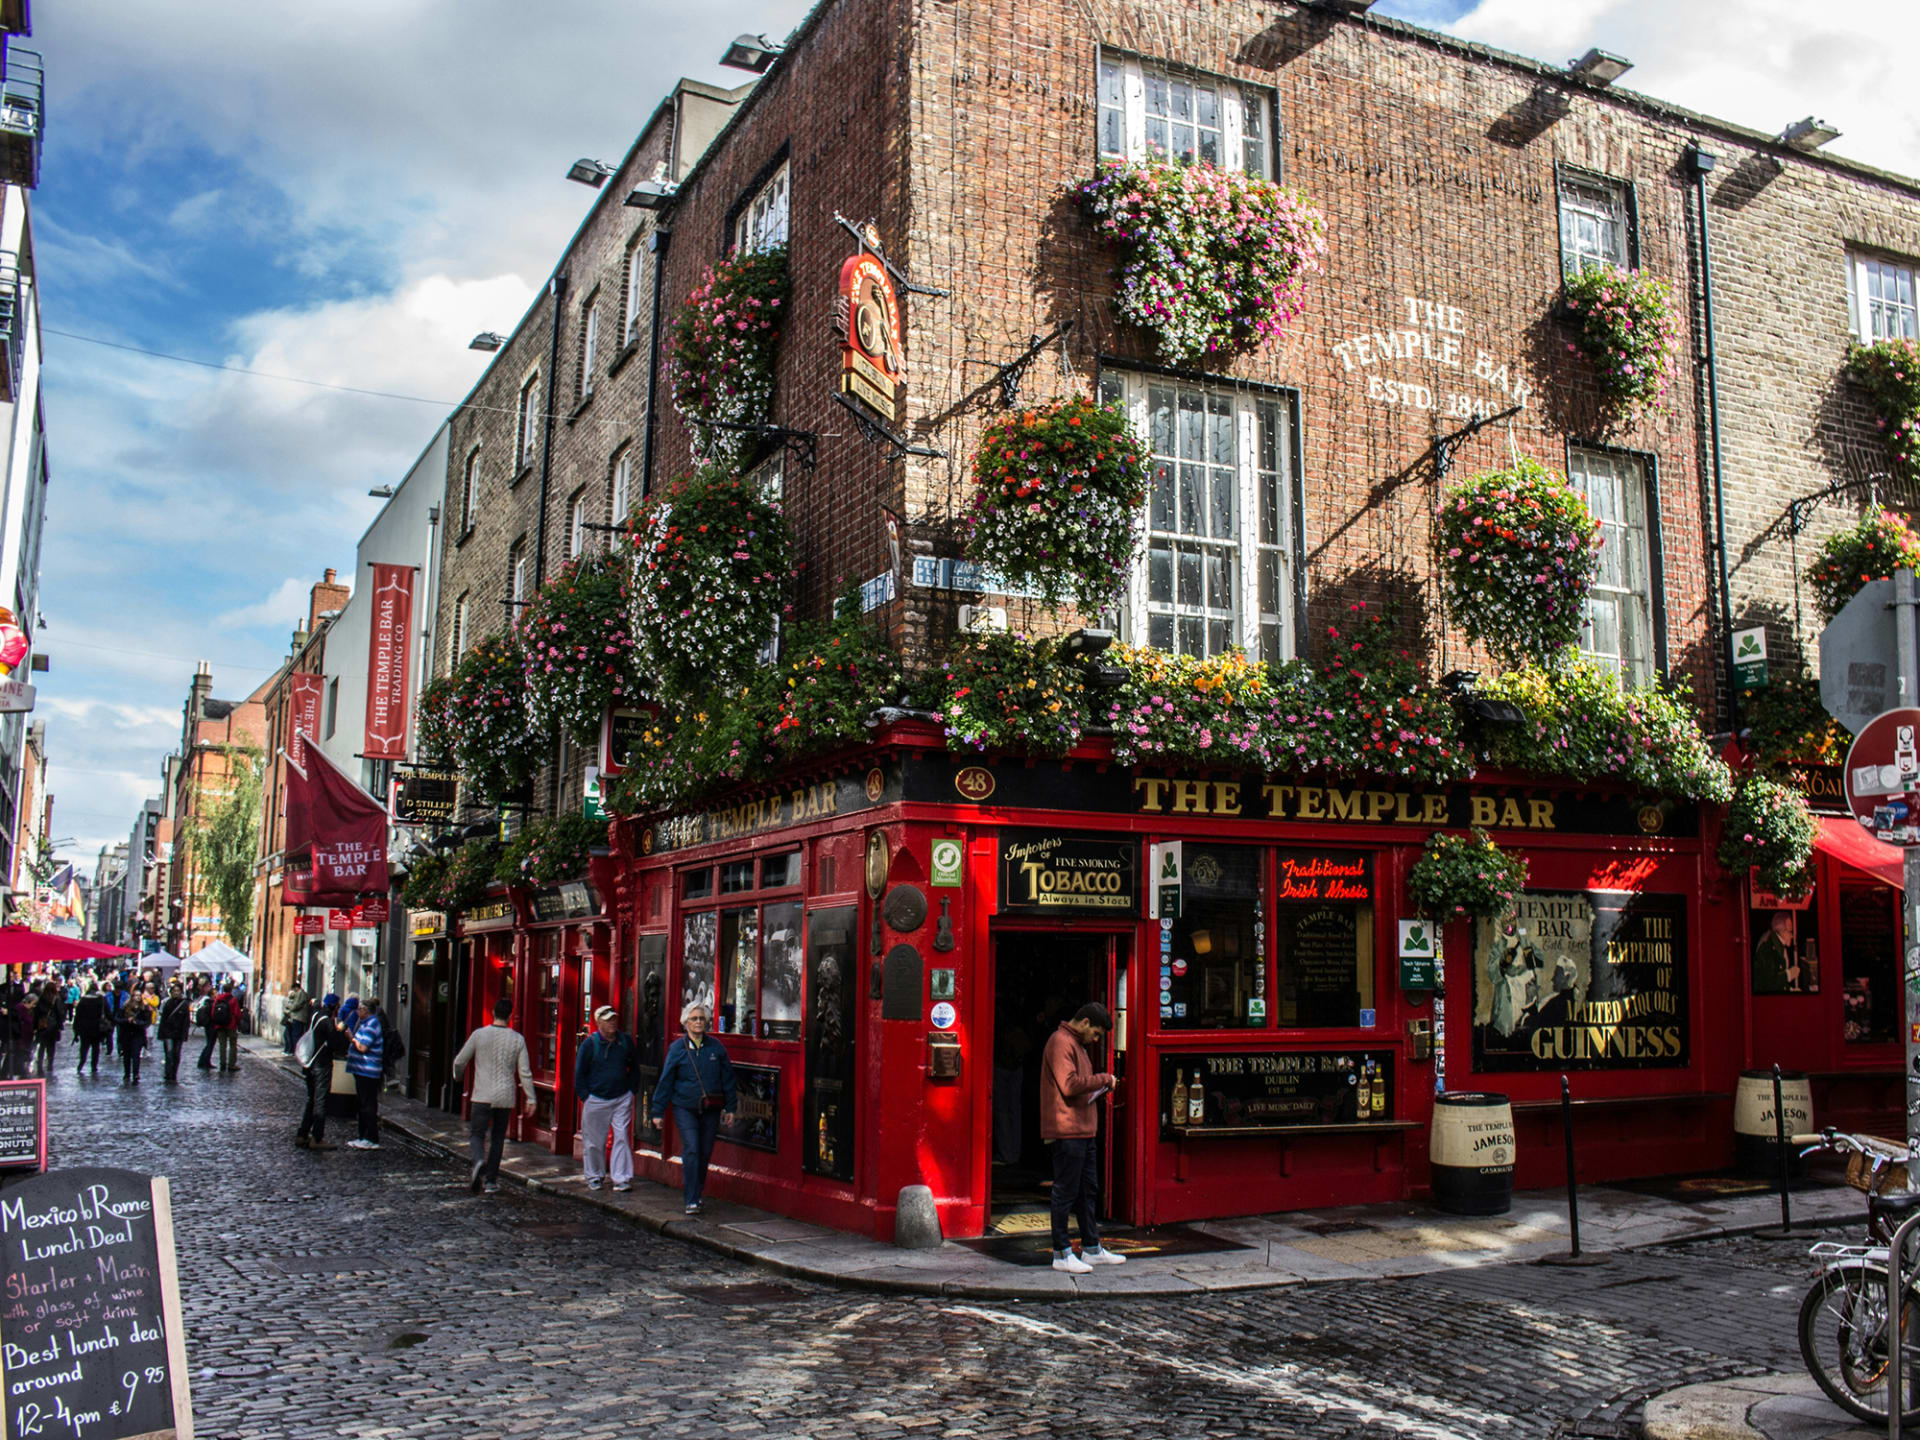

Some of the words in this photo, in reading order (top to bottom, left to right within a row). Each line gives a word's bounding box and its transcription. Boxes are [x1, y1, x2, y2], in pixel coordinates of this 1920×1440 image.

[1404, 297, 1466, 336] THE
[1332, 330, 1463, 373] TEMPLE
[1473, 348, 1533, 409] BAR
[381, 599, 394, 629] BAR
[395, 621, 405, 643] CO.
[377, 632, 392, 694] TEMPLE
[391, 645, 403, 706] TRADING
[305, 697, 316, 720] THE
[375, 696, 389, 727] THE
[868, 773, 881, 795] 48
[963, 773, 987, 792] 48
[708, 795, 783, 839] TEMPLE
[792, 781, 838, 821] BAR
[1135, 777, 1243, 815] THE
[1263, 784, 1450, 823] TEMPLE
[1469, 796, 1556, 829] BAR
[1642, 810, 1659, 828] 48
[316, 849, 382, 866] TEMPLE
[336, 842, 362, 852] THE
[1004, 837, 1062, 861] Importers
[1040, 851, 1051, 859] OF
[333, 864, 368, 878] BAR
[1055, 857, 1077, 867] FINE
[1078, 859, 1121, 868] SMOKING
[1281, 858, 1365, 878] Traditional
[1020, 861, 1121, 900] TOBACCO
[1280, 878, 1318, 898] Irish
[1324, 879, 1369, 898] Music
[1041, 894, 1080, 904] Always
[1085, 896, 1095, 904] in
[1098, 895, 1129, 905] Stock
[1297, 911, 1334, 929] TEMPLE
[1518, 901, 1588, 919] TEMPLE
[1643, 917, 1672, 939] THE
[1538, 920, 1573, 939] BAR
[1607, 941, 1672, 964] EMPEROR
[1657, 967, 1672, 988] OF
[1567, 1000, 1623, 1024] MALTED
[1623, 990, 1679, 1018] LIQUORS
[1531, 1026, 1681, 1059] GUINNESS
[1207, 1057, 1245, 1075] THE
[1248, 1056, 1317, 1074] TEMPLE
[1264, 1075, 1300, 1085] DUBLIN
[0, 1105, 34, 1117] OFFEE
[1248, 1103, 1266, 1113] LIVE
[1267, 1102, 1291, 1111] MUSIC
[1293, 1101, 1315, 1111] DAILY
[1761, 1107, 1807, 1122] JAESON
[0, 1139, 34, 1149] ONUTS
[0, 1196, 78, 1233] Mexico
[87, 1184, 151, 1220] Rome
[20, 1226, 86, 1262] Lunch
[86, 1219, 133, 1249] Deal
[6, 1266, 78, 1299] Starter
[97, 1255, 151, 1285] Main
[3, 1303, 30, 1319] with
[36, 1300, 75, 1319] glass
[84, 1291, 103, 1310] of
[112, 1288, 145, 1301] wine
[24, 1322, 41, 1334] or
[55, 1310, 91, 1329] soft
[102, 1306, 139, 1321] drink
[2, 1334, 62, 1371] Best
[68, 1325, 119, 1356] lunch
[130, 1315, 165, 1343] deal
[12, 1360, 84, 1395] around
